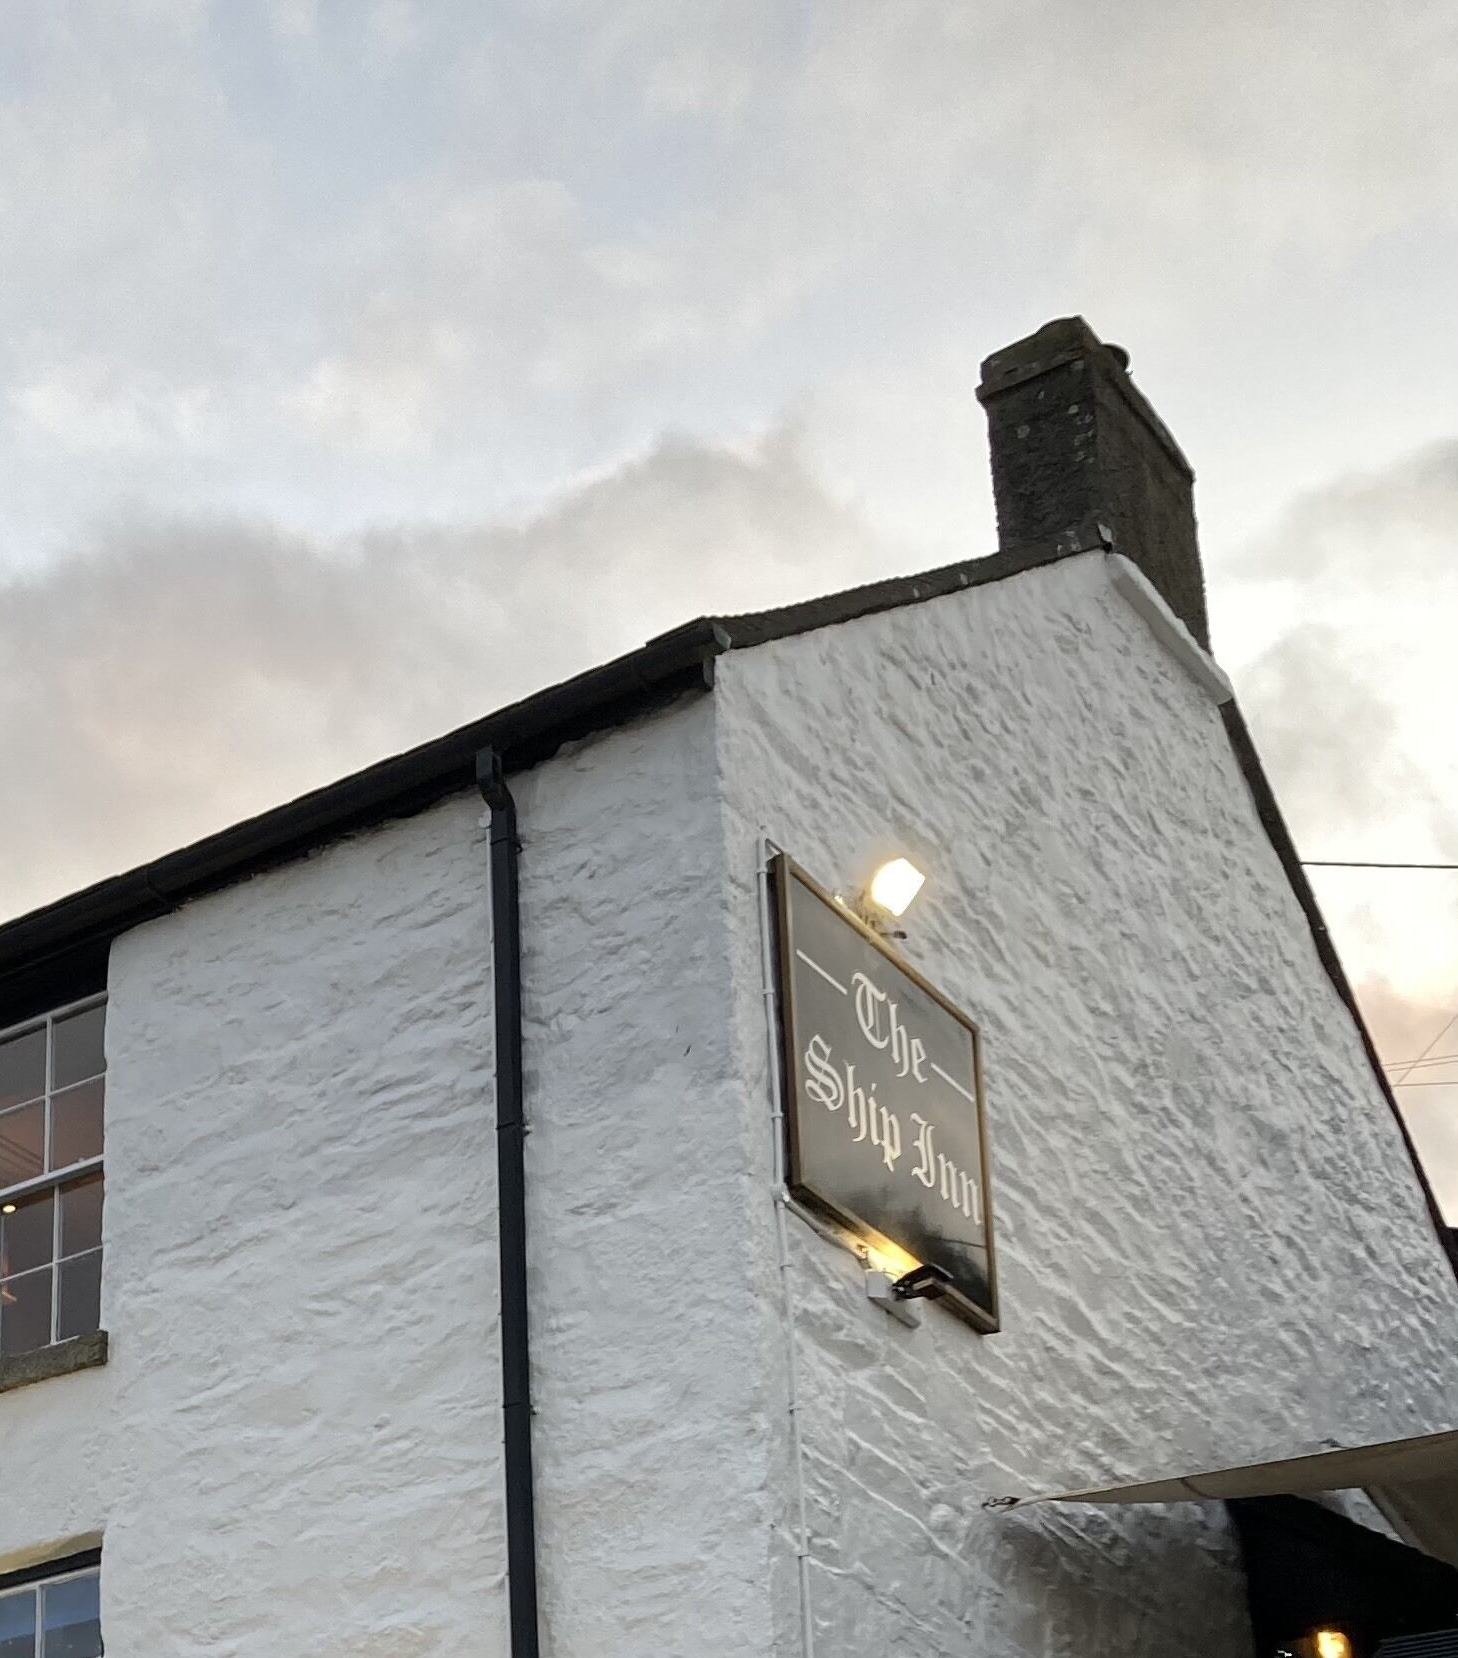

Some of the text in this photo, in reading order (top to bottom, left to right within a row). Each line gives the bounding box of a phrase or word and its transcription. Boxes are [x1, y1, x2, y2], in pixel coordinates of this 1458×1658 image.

[852, 972, 927, 1083] The
[805, 1035, 982, 1225] Ship Inn
